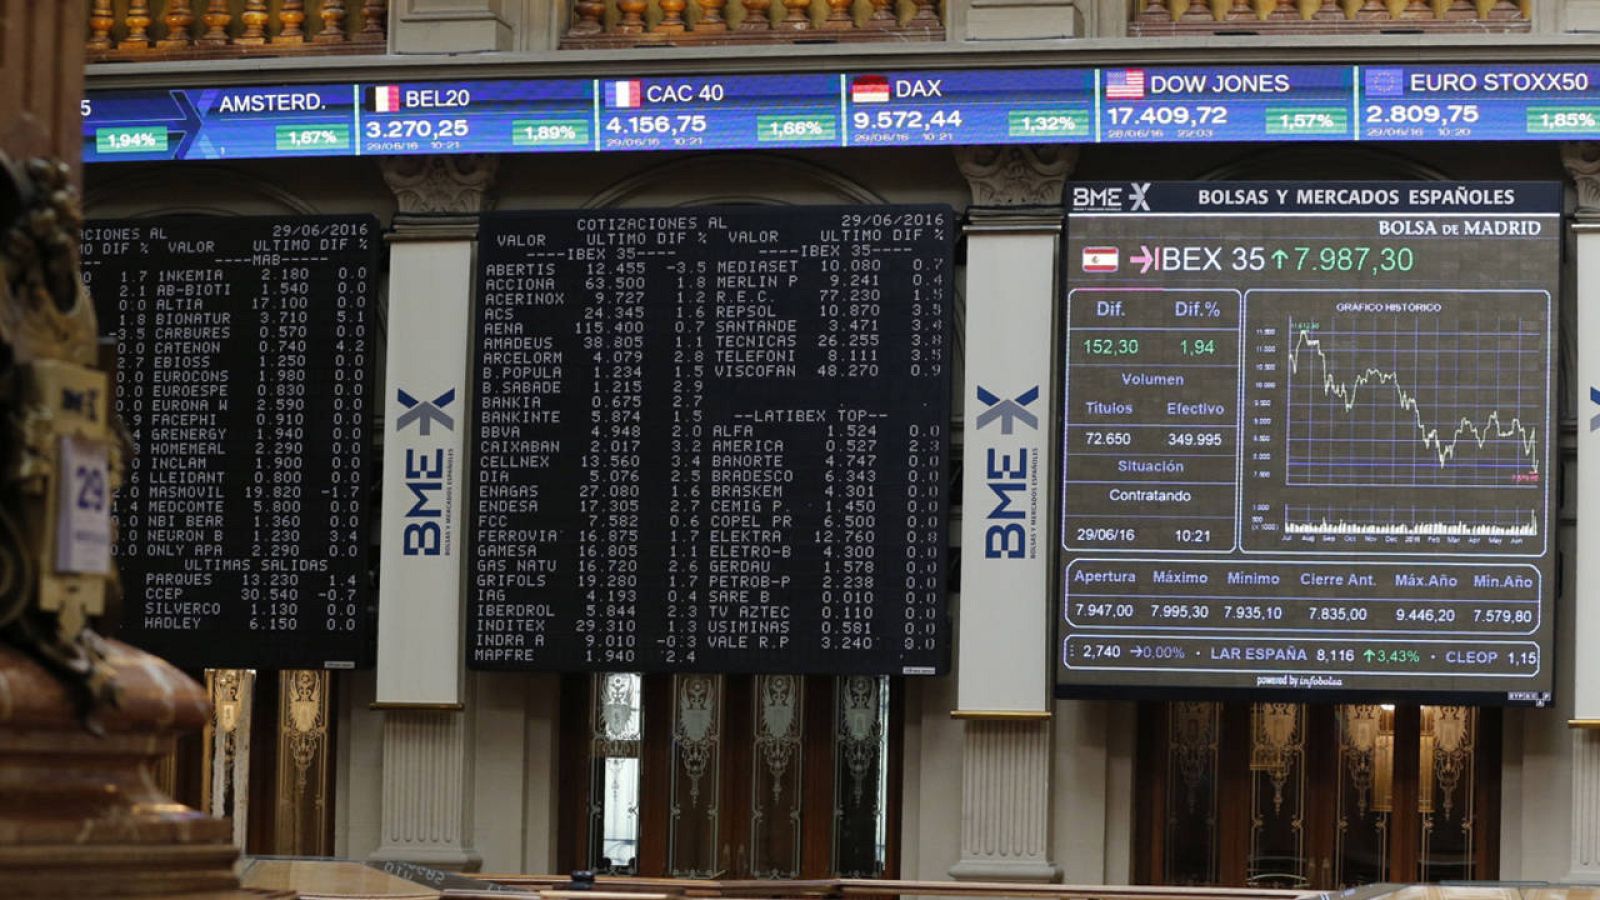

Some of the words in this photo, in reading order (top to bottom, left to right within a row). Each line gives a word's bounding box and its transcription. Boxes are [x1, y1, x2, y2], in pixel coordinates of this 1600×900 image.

[896, 80, 942, 97] DAX
[1151, 75, 1207, 93] DOW
[1212, 74, 1290, 93] JONES
[1411, 73, 1477, 91] EURO
[1484, 72, 1589, 91] STOXX50
[405, 89, 470, 107] BEL20
[647, 84, 693, 102] CAC
[699, 84, 724, 101] 40
[219, 93, 327, 113] AMSTERD.
[853, 110, 962, 131] 9.572,44
[1107, 106, 1228, 128] 17.409,72
[1280, 113, 1334, 130] 1,57%
[1366, 104, 1480, 126] 2.809,75
[1541, 112, 1596, 130] 1,85%
[365, 119, 469, 140] 3.270,25
[606, 115, 707, 136] 4.156,75
[1022, 116, 1076, 133] 1,32%
[1073, 187, 1123, 207] BME
[1198, 189, 1269, 205] BOLSAS
[1276, 189, 1289, 205] Y
[1296, 189, 1399, 205] MERCADOS
[1409, 186, 1515, 205] ESPAÑOLES
[577, 218, 698, 231] COTIZACIONES
[708, 216, 727, 229] AL
[841, 214, 944, 227] 29/06/2016
[1379, 220, 1438, 236] BOLSA
[1464, 220, 1542, 236] MADRID
[272, 223, 368, 237] 29/06/2016
[497, 234, 546, 247] VALOR
[586, 232, 646, 245] ULTIMO
[657, 231, 687, 245] DIF
[697, 232, 707, 244] %
[728, 230, 779, 243] VALOR
[820, 229, 882, 242] ULTIMO
[892, 228, 923, 241] DIF
[934, 228, 944, 241] %
[168, 240, 215, 253] VALOR
[253, 238, 311, 251] ULTIMO
[320, 238, 348, 251] DIF
[717, 260, 798, 273] MEDIASET
[820, 258, 881, 272] 10.080
[1154, 246, 1223, 271] IBEX
[1231, 246, 1265, 271] 35
[1295, 247, 1414, 276] 7.987,30
[486, 263, 556, 276] ABERTIS
[586, 261, 646, 275] 12.455
[666, 260, 706, 274] -3.5
[485, 278, 555, 291] ACCIONA
[585, 276, 646, 290] 63.500
[677, 276, 706, 290] 1.8
[717, 275, 778, 288] MERLIN
[788, 274, 798, 287] P
[156, 298, 203, 311] ALTIA
[485, 292, 565, 305] ACERINOX
[595, 291, 645, 305] 9.727
[484, 307, 514, 320] ACS
[584, 306, 645, 320] 24.345
[716, 305, 776, 318] REPSOL
[1096, 301, 1126, 317] Dif.
[1175, 301, 1221, 318] Dif.%
[484, 322, 524, 335] AENA
[575, 320, 644, 335] 115.400
[715, 319, 797, 332] SANTANDE
[155, 327, 230, 340] CARBURES
[716, 334, 797, 348] TECNICAS
[484, 336, 553, 350] AMADEUS
[1083, 339, 1139, 356] 152,30
[1180, 339, 1216, 356] 1,94
[714, 364, 796, 378] VISCOFAN
[1122, 373, 1184, 385] Volumen
[482, 396, 541, 409] BANKIA
[1167, 402, 1225, 415] Efectivo
[151, 414, 216, 426] FACEPHI
[1085, 432, 1131, 445] 72.650
[1168, 433, 1222, 446] 349.995
[480, 455, 549, 468] CELLNEX
[581, 454, 640, 468] 13.560
[712, 454, 783, 468] BANORTE
[1118, 459, 1184, 473] Situación
[150, 471, 225, 484] LLEIDANT
[711, 469, 793, 483] BRADESCO
[149, 486, 225, 499] MASMOVIL
[245, 485, 301, 499] 19.820
[479, 485, 539, 498] ENAGAS
[1109, 489, 1192, 502] Contratando
[403, 448, 444, 556] BME
[985, 448, 1028, 559] BME
[1077, 529, 1135, 542] 29/06/16
[1175, 530, 1211, 542] 10:21
[184, 559, 250, 571] ULTIMAS
[261, 560, 328, 572] SALIDAS
[146, 573, 213, 586] PARQUES
[242, 574, 299, 587] 13.230
[1074, 570, 1136, 585] Apertura
[1153, 570, 1208, 584] Máximo
[1301, 573, 1344, 586] Cierre
[1348, 574, 1377, 587] Ant.
[145, 587, 183, 600] CCEP
[145, 602, 221, 615] SILVERCO
[1076, 603, 1134, 618] 7.947,00
[1151, 604, 1209, 619] 7.995,30
[1224, 605, 1283, 621] 7.935,10
[1309, 607, 1368, 623] 7.835,00
[1396, 608, 1456, 624] 9.446,20
[1474, 608, 1533, 624] 7.579,80
[476, 619, 545, 632] INDITEX
[575, 618, 636, 632] 29.310
[708, 620, 790, 634] USIMINAS
[474, 648, 534, 661] MAPFRE
[586, 647, 635, 662] 1.940
[1083, 645, 1121, 660] 2,740
[1143, 646, 1185, 660] 0,00%
[1210, 647, 1241, 660] LAR
[1245, 645, 1308, 662] ESPAÑA
[1316, 649, 1355, 664] 8,116
[1378, 650, 1420, 664] 3,43%
[1445, 651, 1498, 665] CLEOP
[1508, 652, 1537, 667] 1,15
